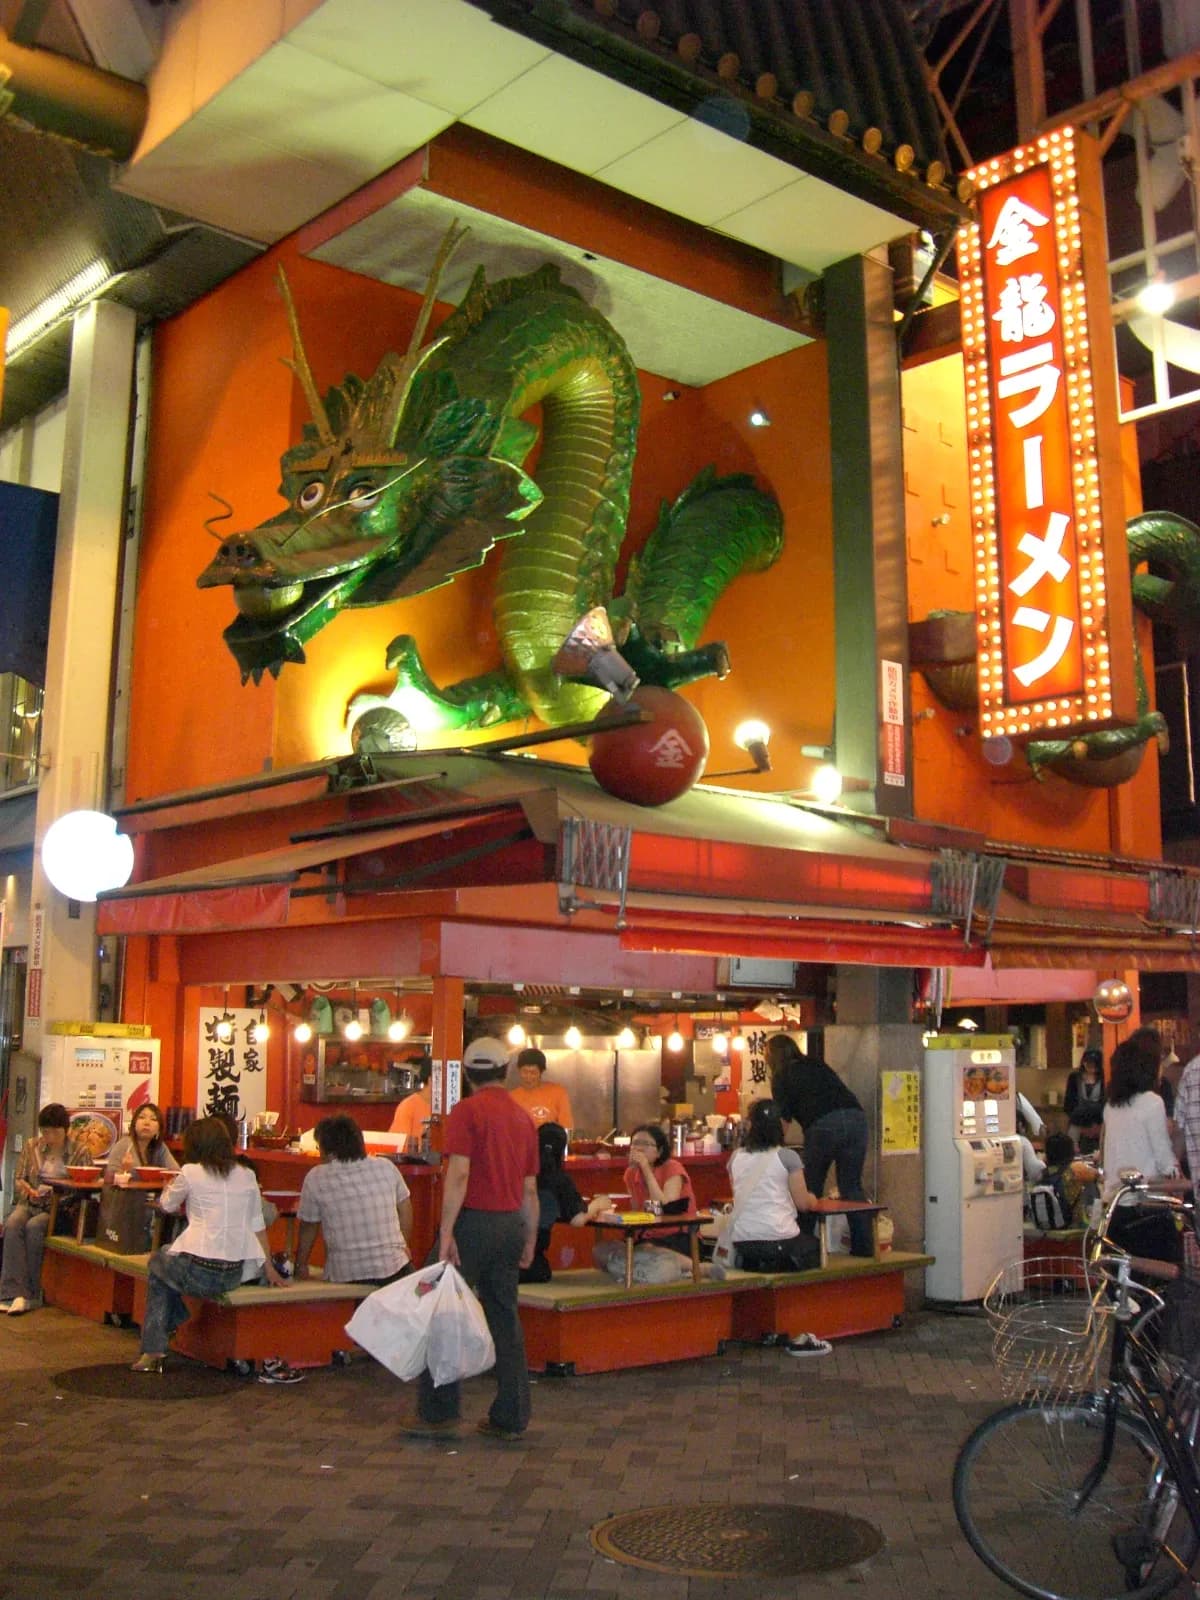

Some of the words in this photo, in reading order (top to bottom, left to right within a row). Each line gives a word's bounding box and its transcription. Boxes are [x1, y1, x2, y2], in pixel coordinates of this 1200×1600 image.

[986, 194, 1075, 688] 金龍ラーメン
[650, 728, 693, 769] 金
